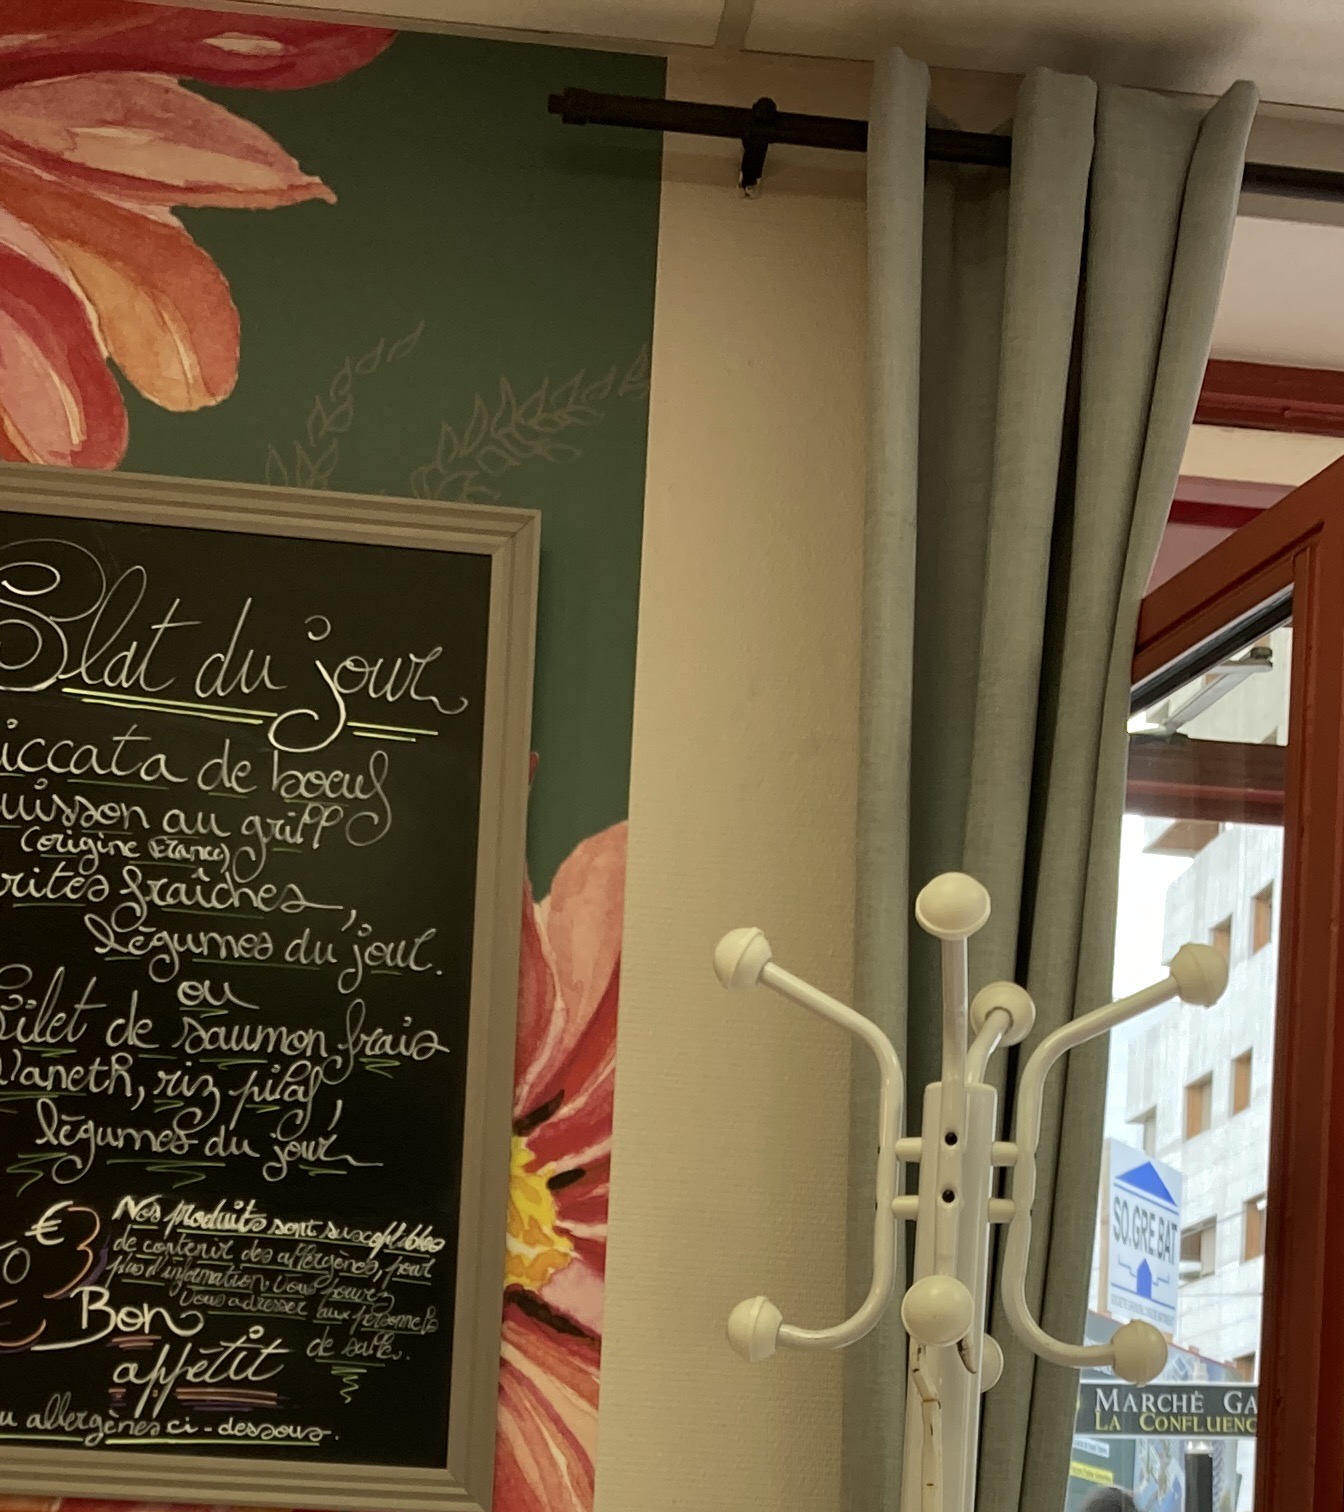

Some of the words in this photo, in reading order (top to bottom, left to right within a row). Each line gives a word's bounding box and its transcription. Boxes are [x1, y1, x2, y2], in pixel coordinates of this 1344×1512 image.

[195, 597, 288, 697] du
[268, 615, 468, 752] jour
[162, 810, 231, 838] au
[197, 738, 256, 794] de
[272, 749, 392, 847] boeuf
[84, 913, 274, 982] légumes
[285, 927, 337, 964] du
[177, 976, 260, 1010] ou
[104, 990, 160, 1049] de
[173, 1014, 328, 1058] saumon
[318, 998, 451, 1085] frais
[153, 1062, 221, 1132] riz
[36, 1098, 198, 1185] légumes
[204, 1117, 260, 1157] du
[262, 1133, 385, 1181] jour
[24, 1200, 74, 1246] €
[111, 1194, 163, 1223] Nos
[164, 1199, 268, 1240] produits
[267, 1218, 324, 1238] sont
[326, 1220, 446, 1259] susceptibles
[1113, 1196, 1178, 1266] SO.GRE.BAT
[105, 1253, 147, 1289] plus
[319, 1279, 395, 1314] pouvez
[113, 1224, 137, 1252] de
[142, 1236, 234, 1261] contenir
[241, 1239, 272, 1264] des
[383, 1258, 434, 1290] pour
[30, 1285, 204, 1351] Bon
[228, 1294, 308, 1315] adresser
[317, 1300, 351, 1320] aux
[112, 1325, 291, 1417] appétit
[306, 1326, 334, 1357] de
[26, 1391, 161, 1448] allergènes
[1094, 1410, 1121, 1431] LA
